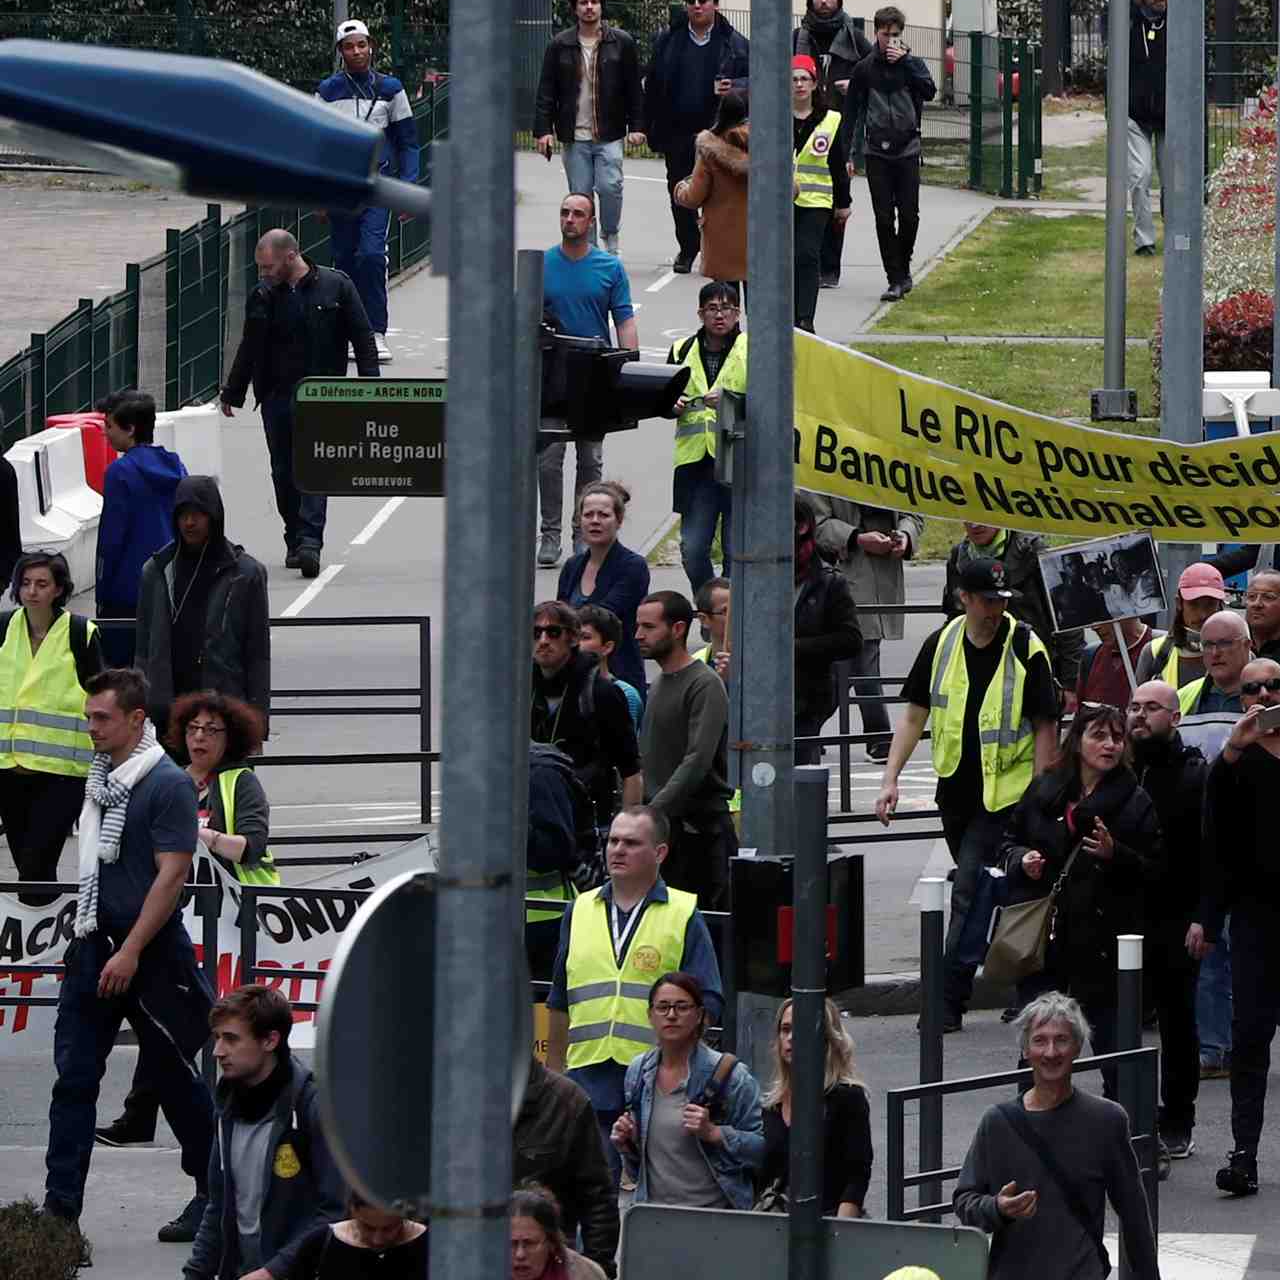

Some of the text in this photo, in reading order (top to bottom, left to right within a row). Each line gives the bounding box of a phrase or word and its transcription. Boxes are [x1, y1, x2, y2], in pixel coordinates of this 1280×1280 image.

[305, 387, 318, 397] La
[374, 387, 409, 397] ARCHE
[413, 387, 442, 397] NORD
[366, 421, 399, 438] Rue
[899, 388, 942, 444] Le
[954, 406, 1023, 465] RIC
[1034, 438, 1134, 484] pour
[313, 441, 363, 459] Henri
[352, 477, 413, 487] COURBEVOIE
[814, 425, 967, 506] Banque
[973, 471, 1203, 528] Nationale
